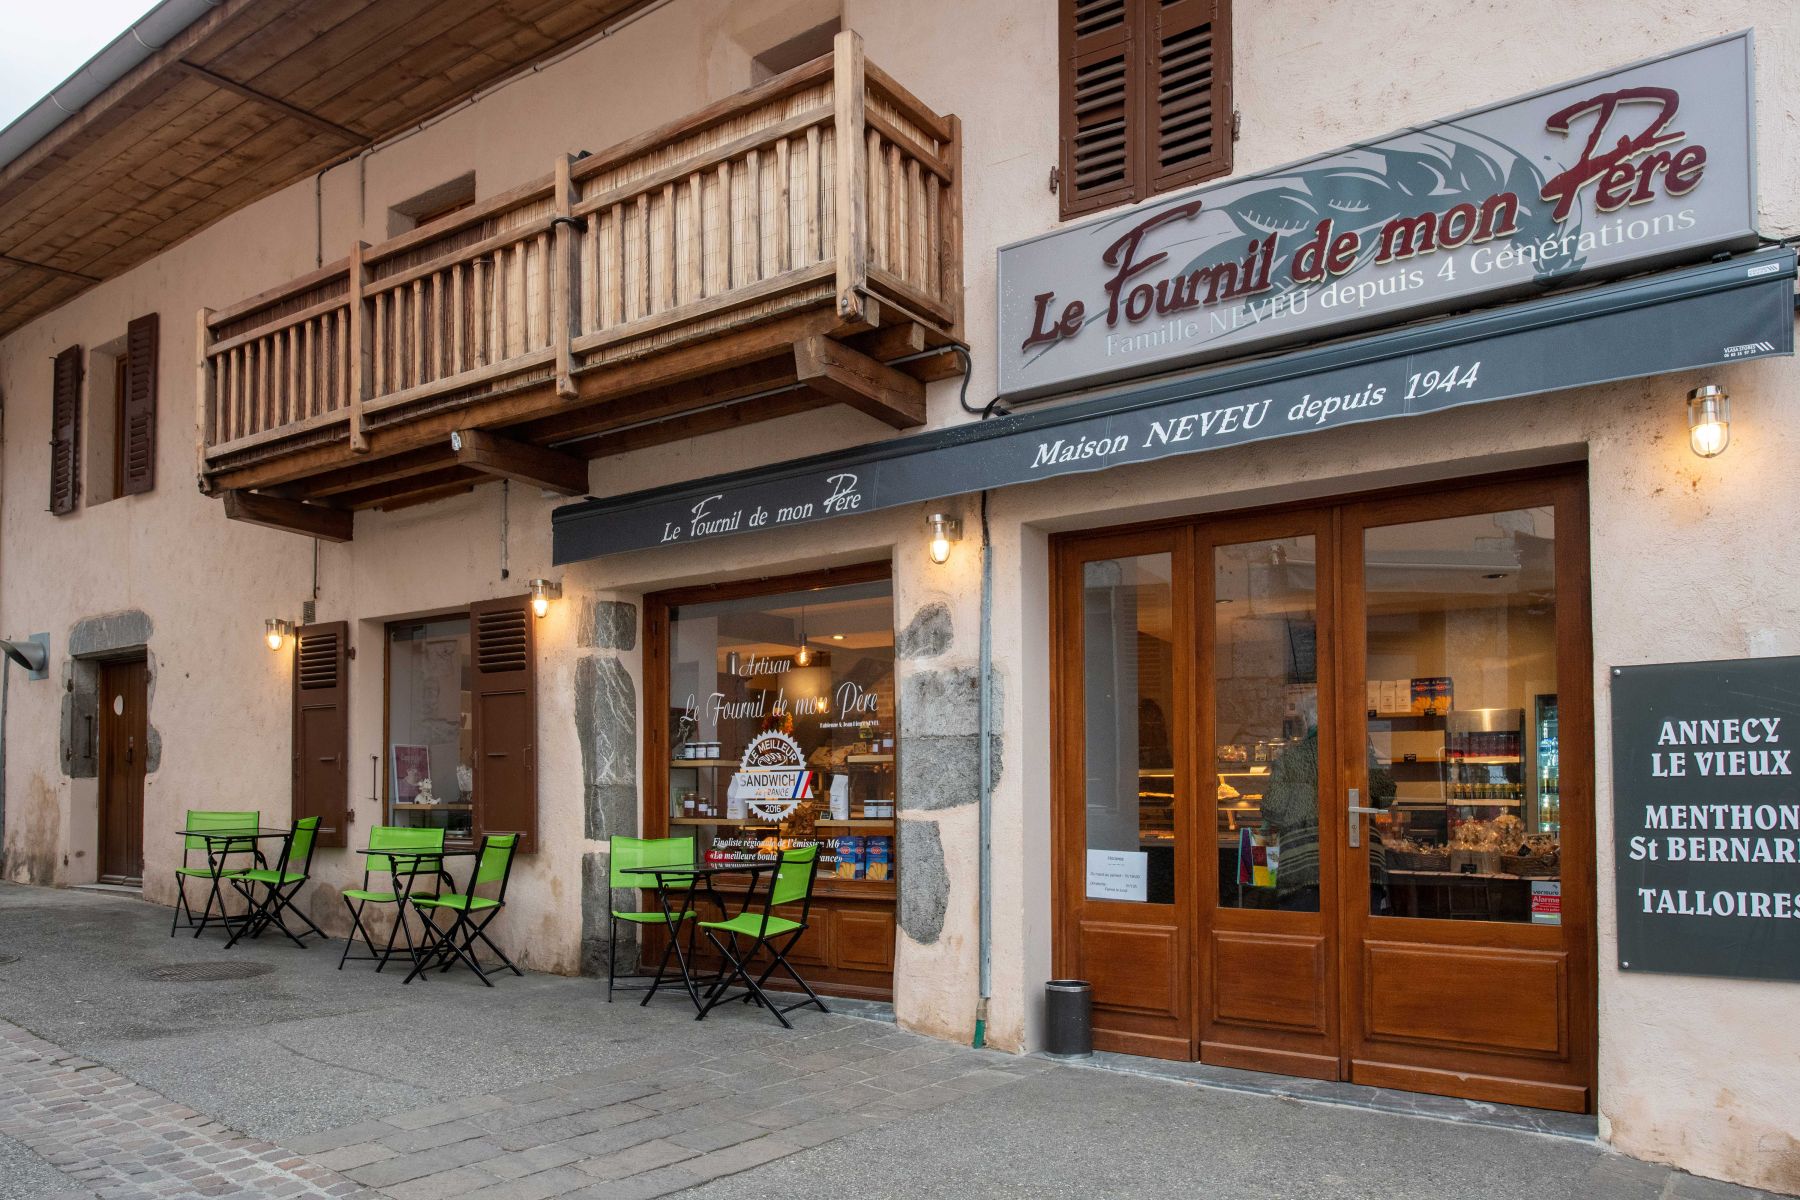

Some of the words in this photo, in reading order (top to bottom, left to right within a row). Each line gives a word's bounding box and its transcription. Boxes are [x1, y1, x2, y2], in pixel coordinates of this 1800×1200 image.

[1022, 291, 1085, 352] Le
[1102, 200, 1279, 328] Fournil
[1291, 217, 1361, 283] de
[1374, 192, 1519, 265] mon
[1541, 86, 1707, 223] Père
[1106, 317, 1199, 356] Famille
[1209, 289, 1309, 334] NEVEU
[1320, 268, 1424, 309] depuis
[1437, 256, 1456, 282] 4
[1470, 208, 1697, 275] Générations
[1030, 430, 1129, 469] Maison
[1142, 400, 1272, 448] NEVEU
[1287, 383, 1387, 426] depuis
[1403, 361, 1482, 400] 1944
[661, 522, 681, 542] Le
[690, 494, 743, 536] Fournil
[749, 506, 768, 527] de
[776, 503, 814, 522] mon
[738, 653, 792, 677] Artisan
[680, 693, 700, 722] Le
[706, 689, 766, 726] Fournil
[772, 688, 790, 717] de
[795, 696, 830, 716] mon
[836, 681, 880, 720] Père
[1658, 718, 1781, 745] ANNECY
[748, 749, 759, 765] LE
[757, 739, 798, 763] MEILLEUR
[1651, 752, 1686, 777] LE
[1694, 750, 1792, 776] VIEUX
[740, 774, 796, 787] SANDWICH
[765, 804, 781, 813] 2016
[1645, 804, 1800, 830] MENTHON
[713, 838, 743, 847] Finaliste
[724, 851, 756, 861] meilleure
[1629, 836, 1659, 861] St
[1667, 837, 1800, 863] BERNAR
